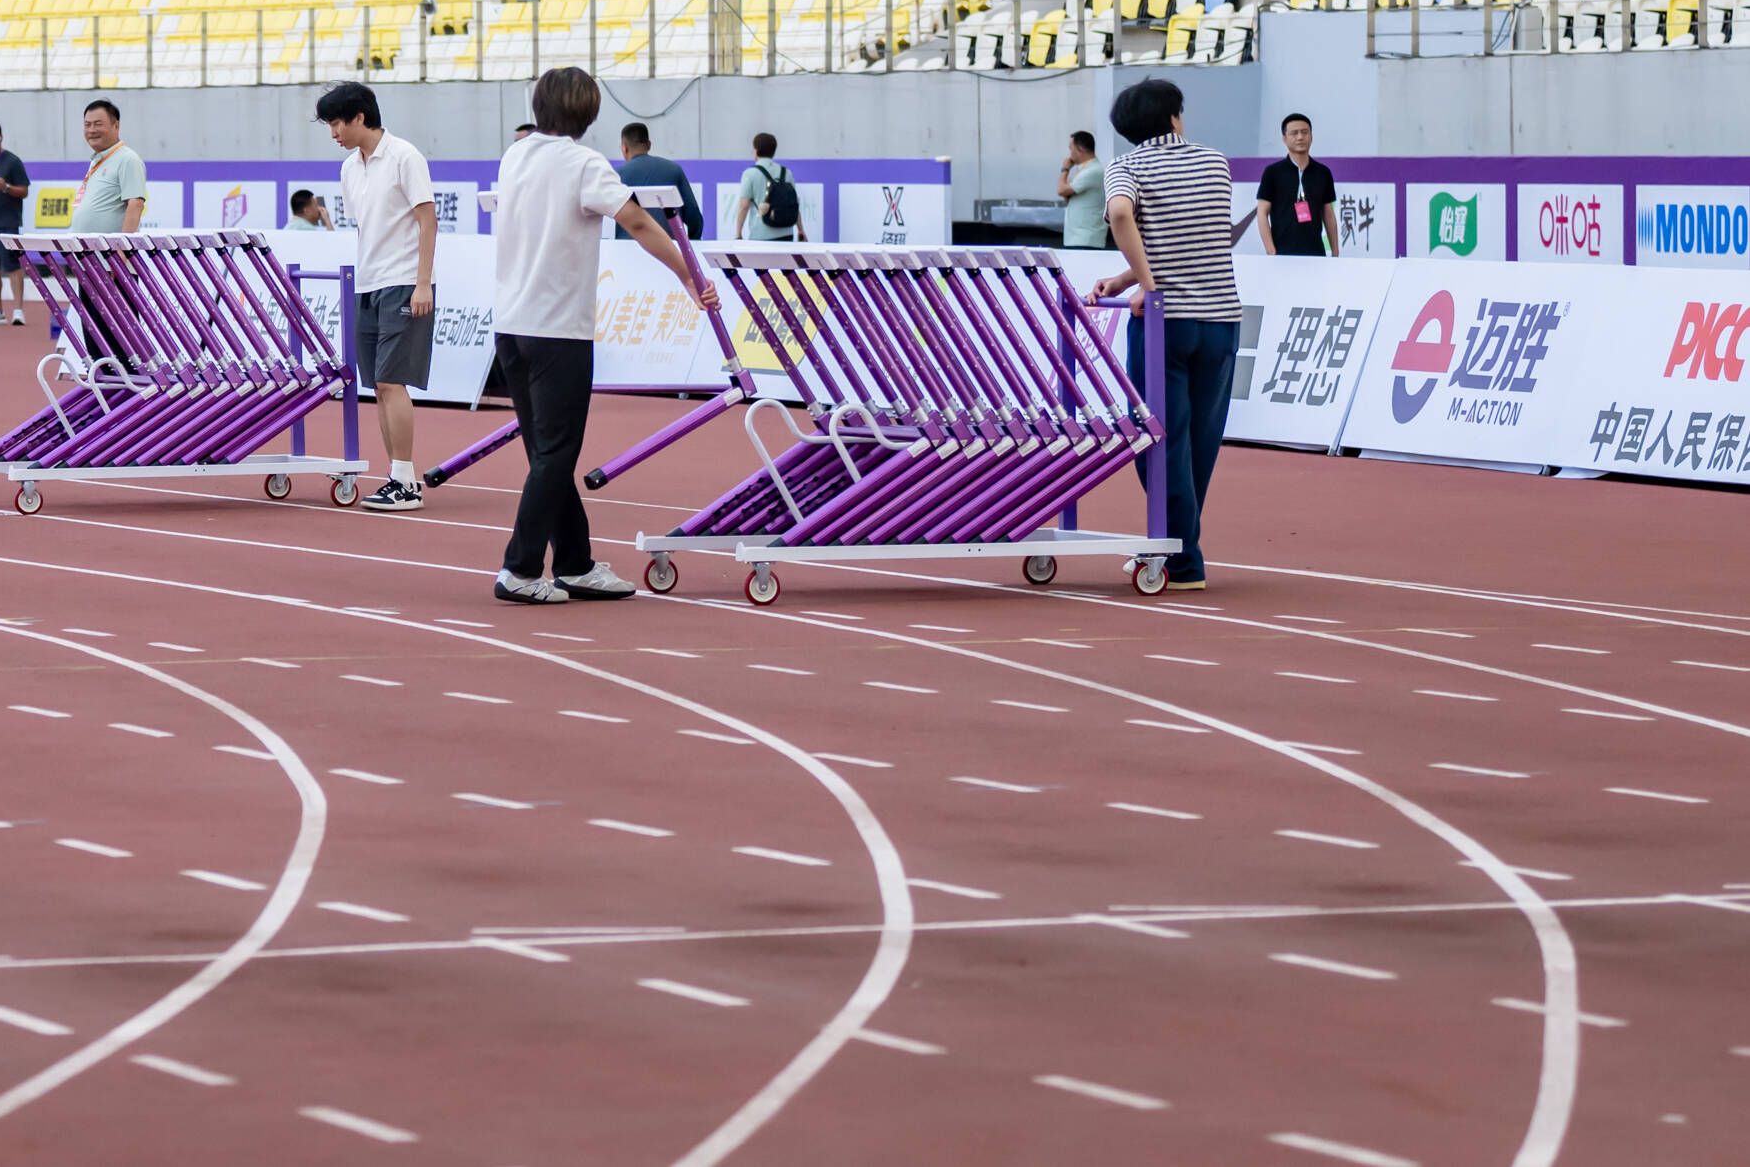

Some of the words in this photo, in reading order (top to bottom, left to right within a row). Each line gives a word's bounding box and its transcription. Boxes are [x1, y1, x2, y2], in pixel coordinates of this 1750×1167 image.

[1339, 194, 1375, 252] 蒙牛
[1539, 194, 1601, 256] 咪咕
[1656, 204, 1748, 254] MONDO
[1261, 305, 1364, 406] 理想
[1449, 298, 1561, 393] 迈胜
[1663, 302, 1750, 382] PICC
[1447, 397, 1523, 427] M-ACTION
